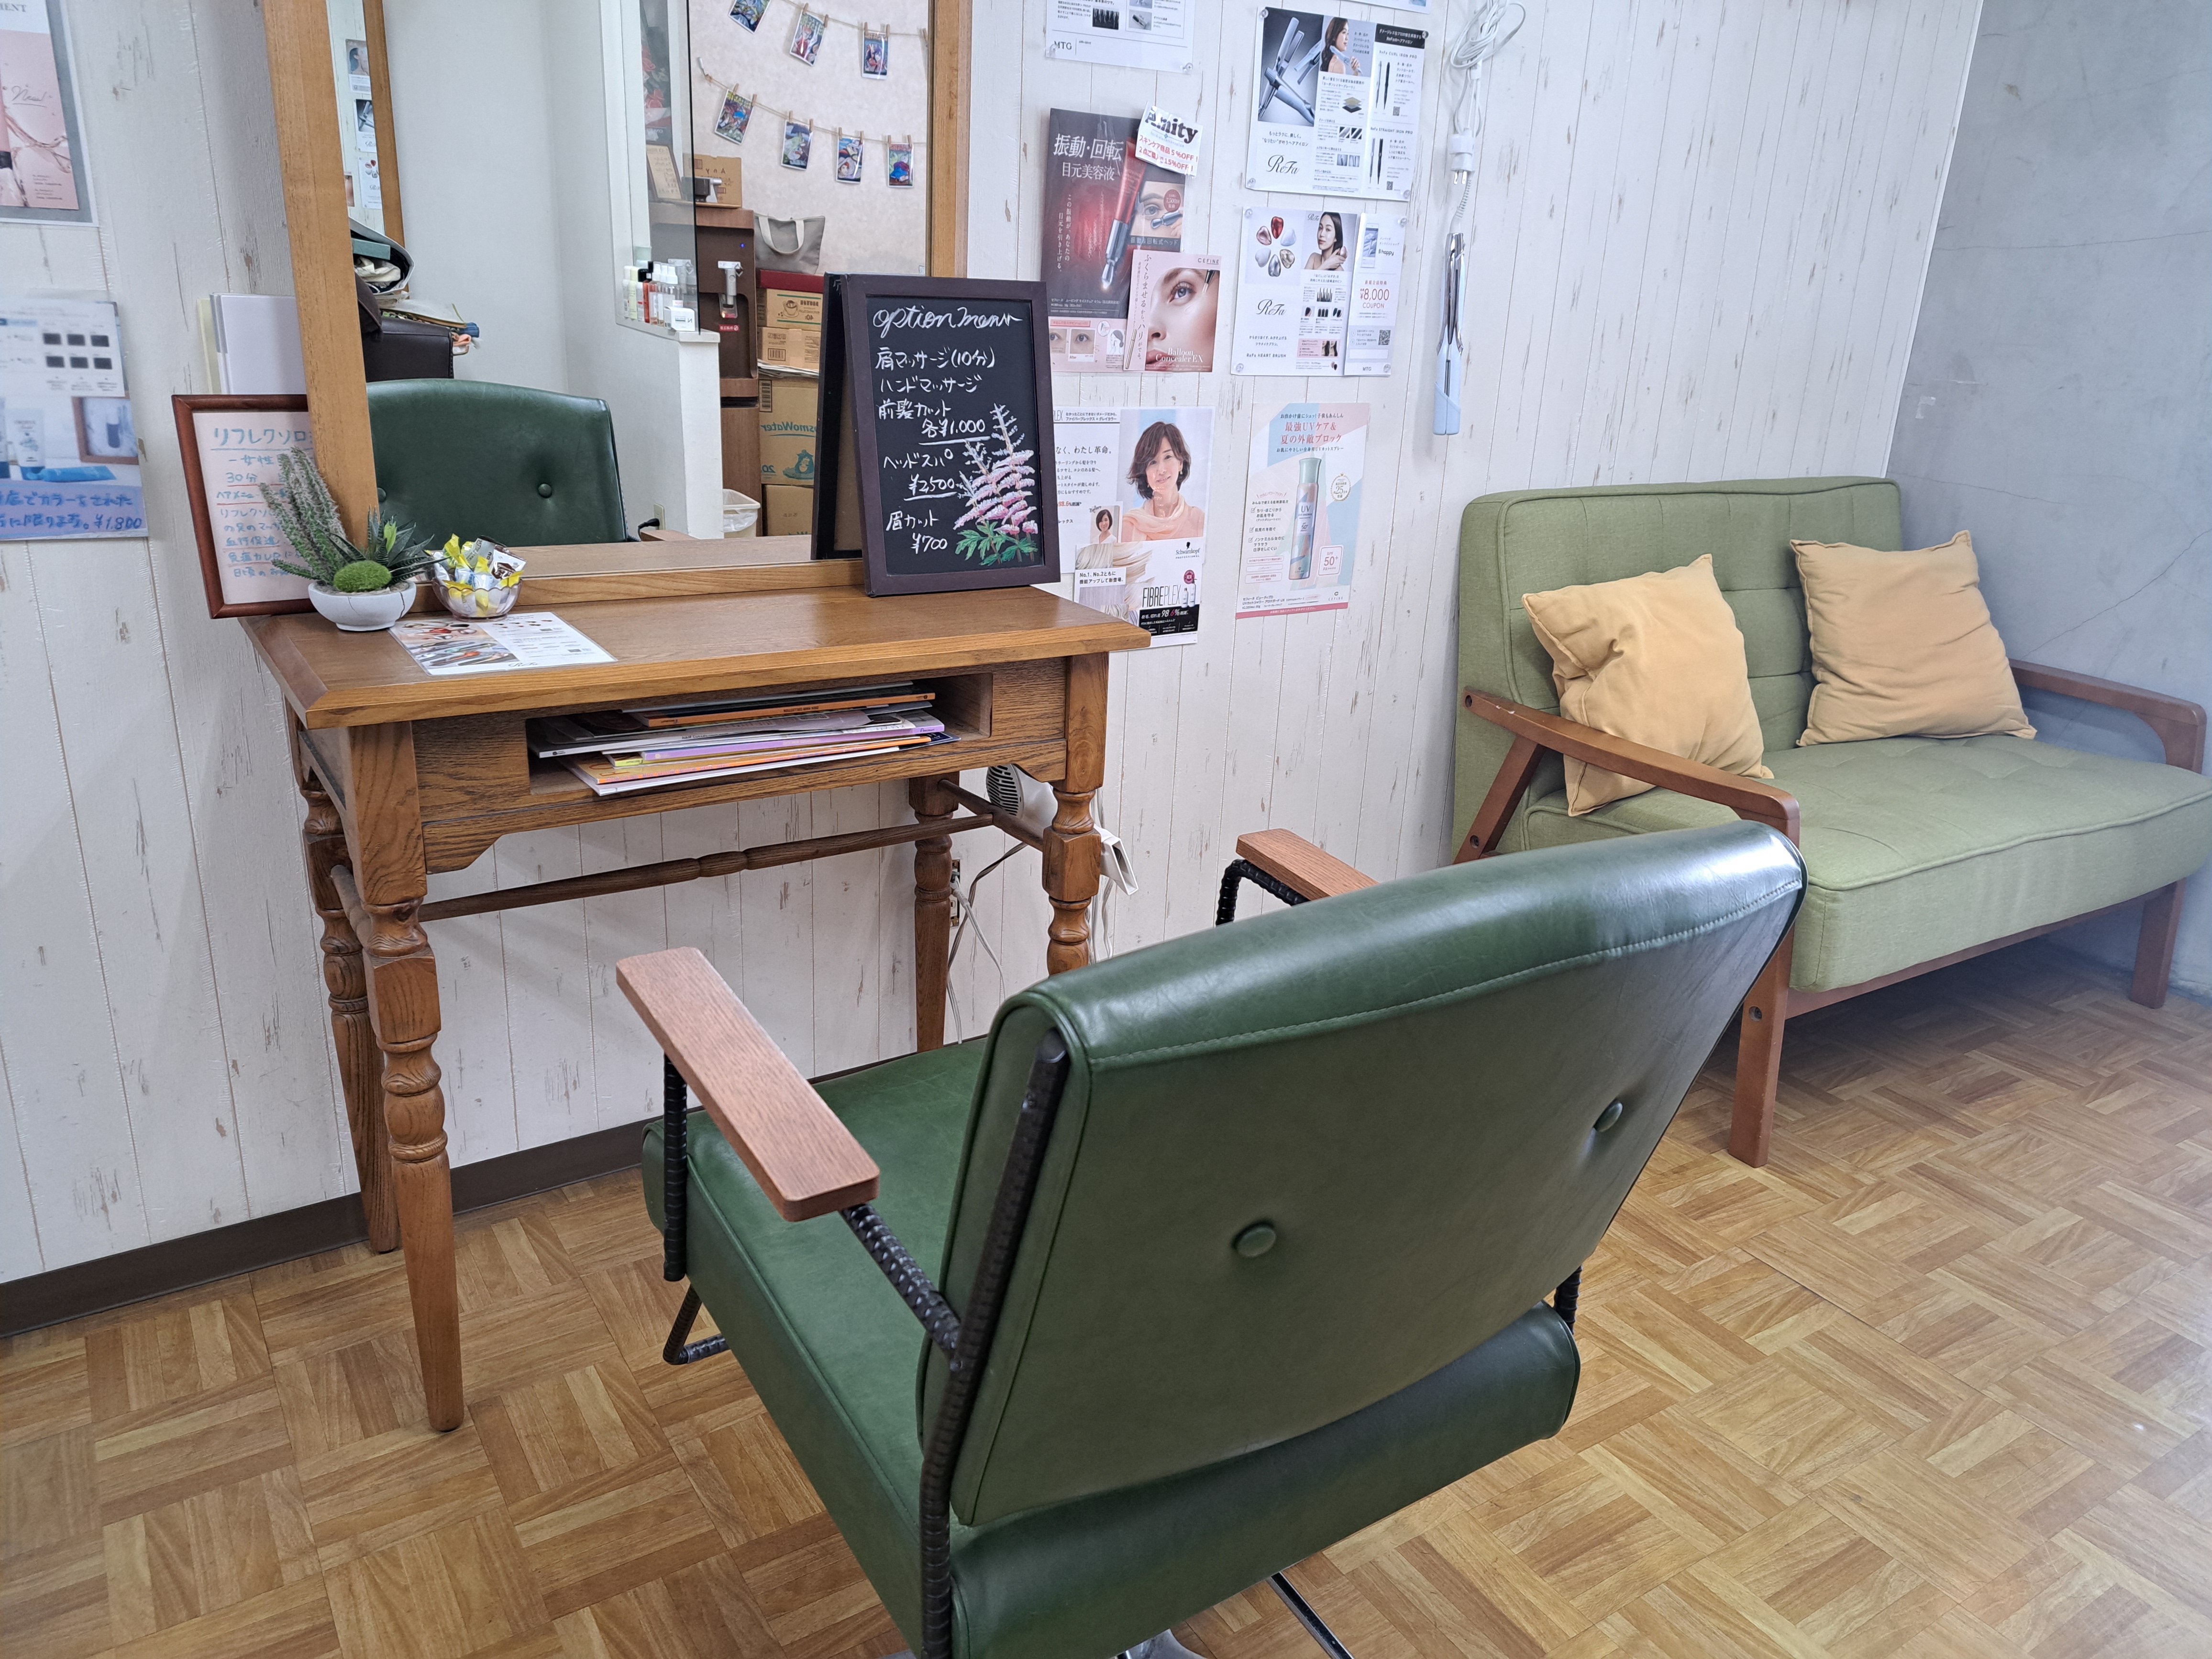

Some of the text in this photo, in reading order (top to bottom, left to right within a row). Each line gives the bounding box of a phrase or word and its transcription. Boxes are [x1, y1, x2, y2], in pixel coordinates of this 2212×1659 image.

[1062, 162, 1115, 181] 目元美容液
[1266, 155, 1300, 174] ReFa
[1256, 299, 1286, 315] ReFa
[873, 305, 957, 338] option
[875, 345, 995, 371] 肩マッサージ(10分)
[1156, 353, 1203, 363] Concealer EX
[881, 374, 982, 393] ハンドマッサージ
[876, 398, 951, 420] 前髪カット
[1285, 421, 1337, 431] 最強UVケア&
[214, 428, 312, 446] リフレクソロ
[1281, 434, 1342, 444] 夏の外敵ブロック
[884, 448, 953, 469] ヘッドスパ
[1056, 446, 1111, 454] なく、わたし革命。
[226, 472, 257, 483] 30分
[886, 509, 940, 531] 眉カット
[911, 532, 948, 554] ¥700
[1142, 585, 1181, 608] FIBREPLEX
